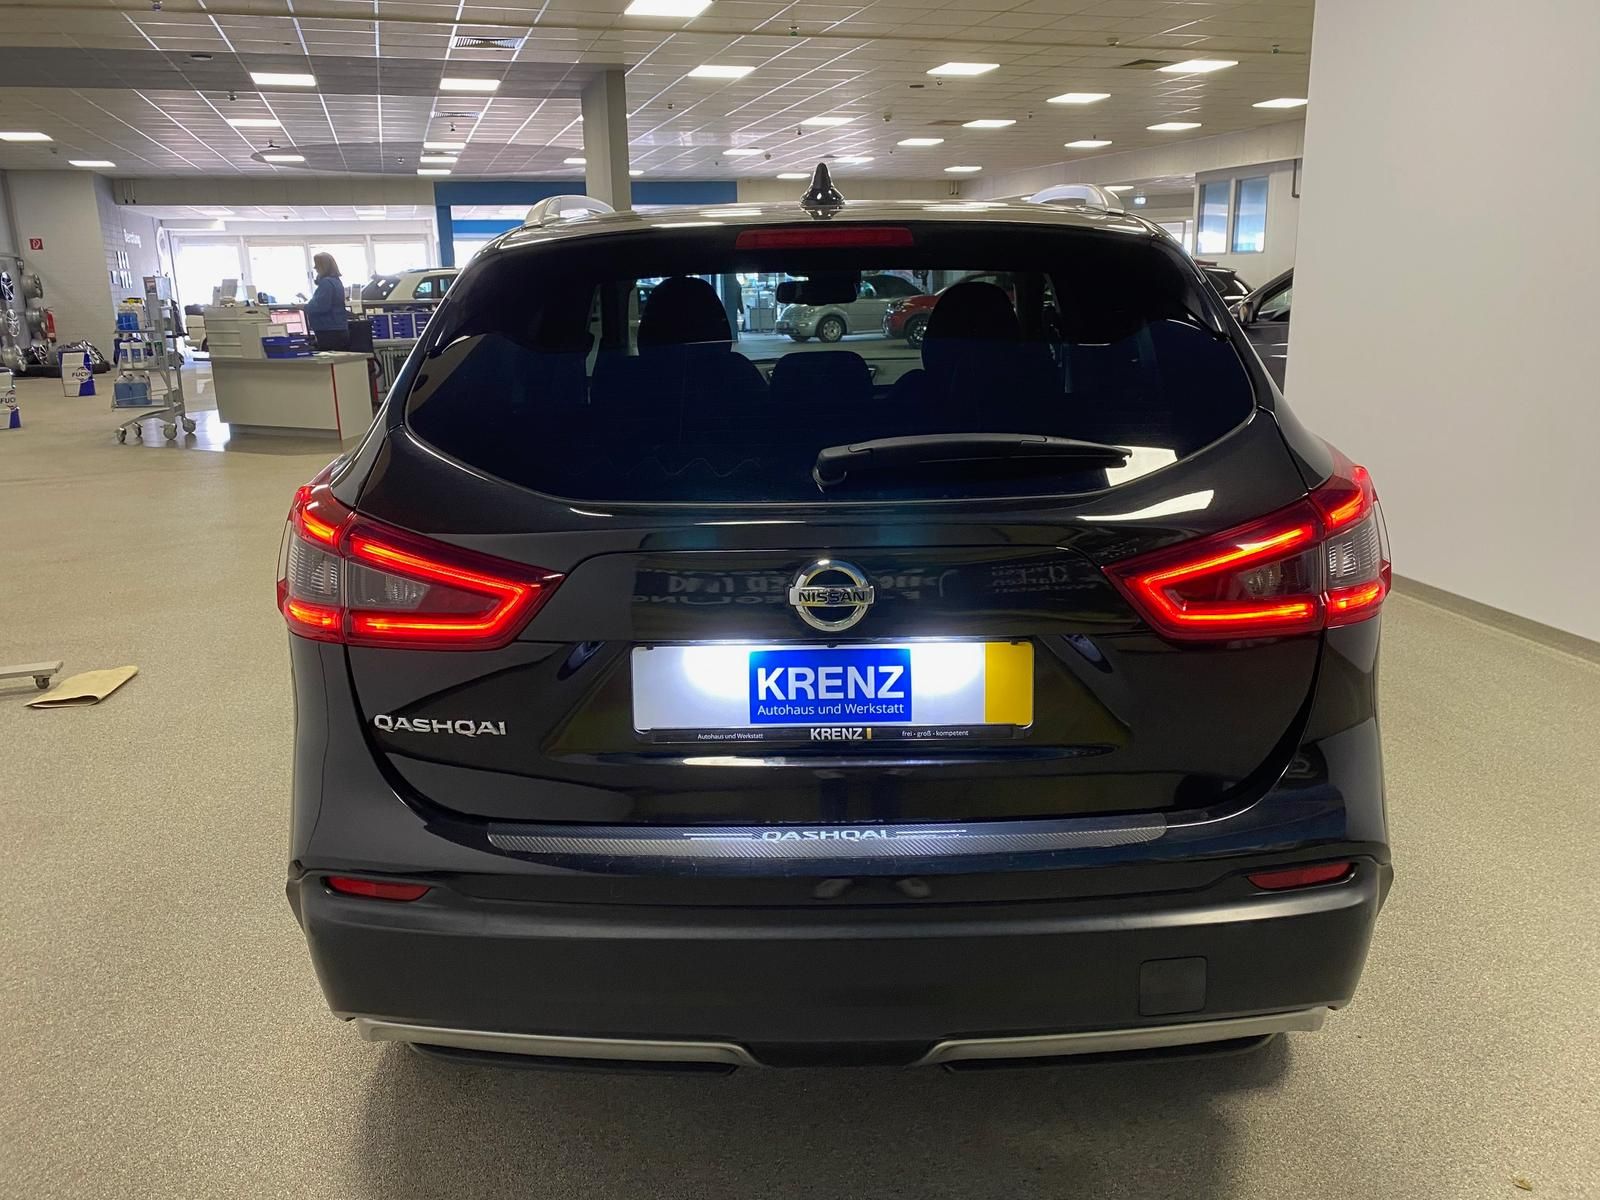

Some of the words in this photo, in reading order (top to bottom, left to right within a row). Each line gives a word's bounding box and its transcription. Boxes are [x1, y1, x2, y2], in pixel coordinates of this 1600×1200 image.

[799, 591, 865, 602] NISSAN
[757, 665, 904, 700] KRENZ
[757, 704, 815, 715] Autohaus
[818, 703, 841, 715] und
[845, 703, 904, 714] Werkstatt
[374, 714, 507, 738] QASHQAI
[810, 728, 863, 741] KRENZ
[936, 730, 969, 738] kompetent
[762, 829, 888, 843] QASHQAI
